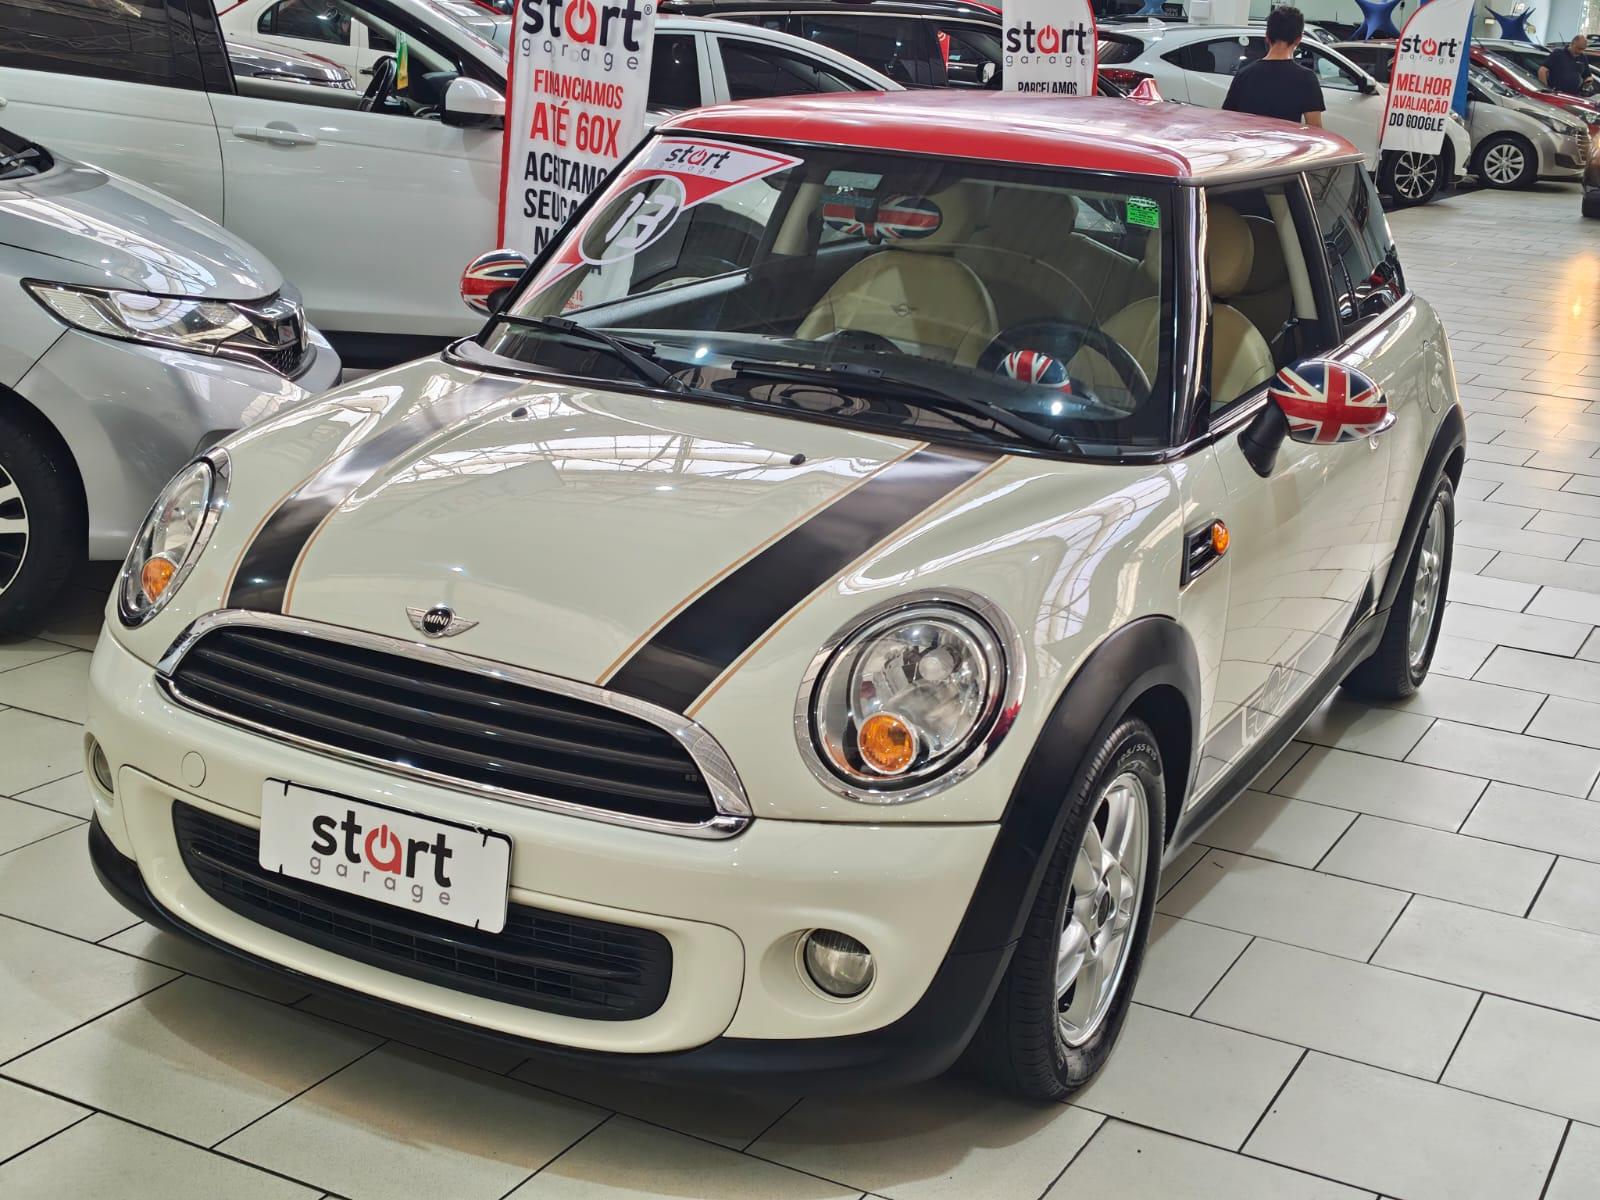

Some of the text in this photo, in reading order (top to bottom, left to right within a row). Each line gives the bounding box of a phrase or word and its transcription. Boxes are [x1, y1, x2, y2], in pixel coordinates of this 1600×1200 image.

[522, 38, 639, 71] garage
[1005, 55, 1086, 67] garage
[533, 69, 623, 109] FINANCIAMOS
[1018, 81, 1077, 95] PARCELAMOS
[1396, 73, 1453, 97] MELHOR
[1392, 95, 1449, 115] AVALIAÇÃO
[530, 101, 621, 158] ATÉ 60X
[1389, 112, 1445, 132] DO GOOGLE
[665, 145, 731, 169] start
[423, 613, 450, 627] MINI
[311, 810, 453, 888] start
[309, 856, 451, 905] garage
